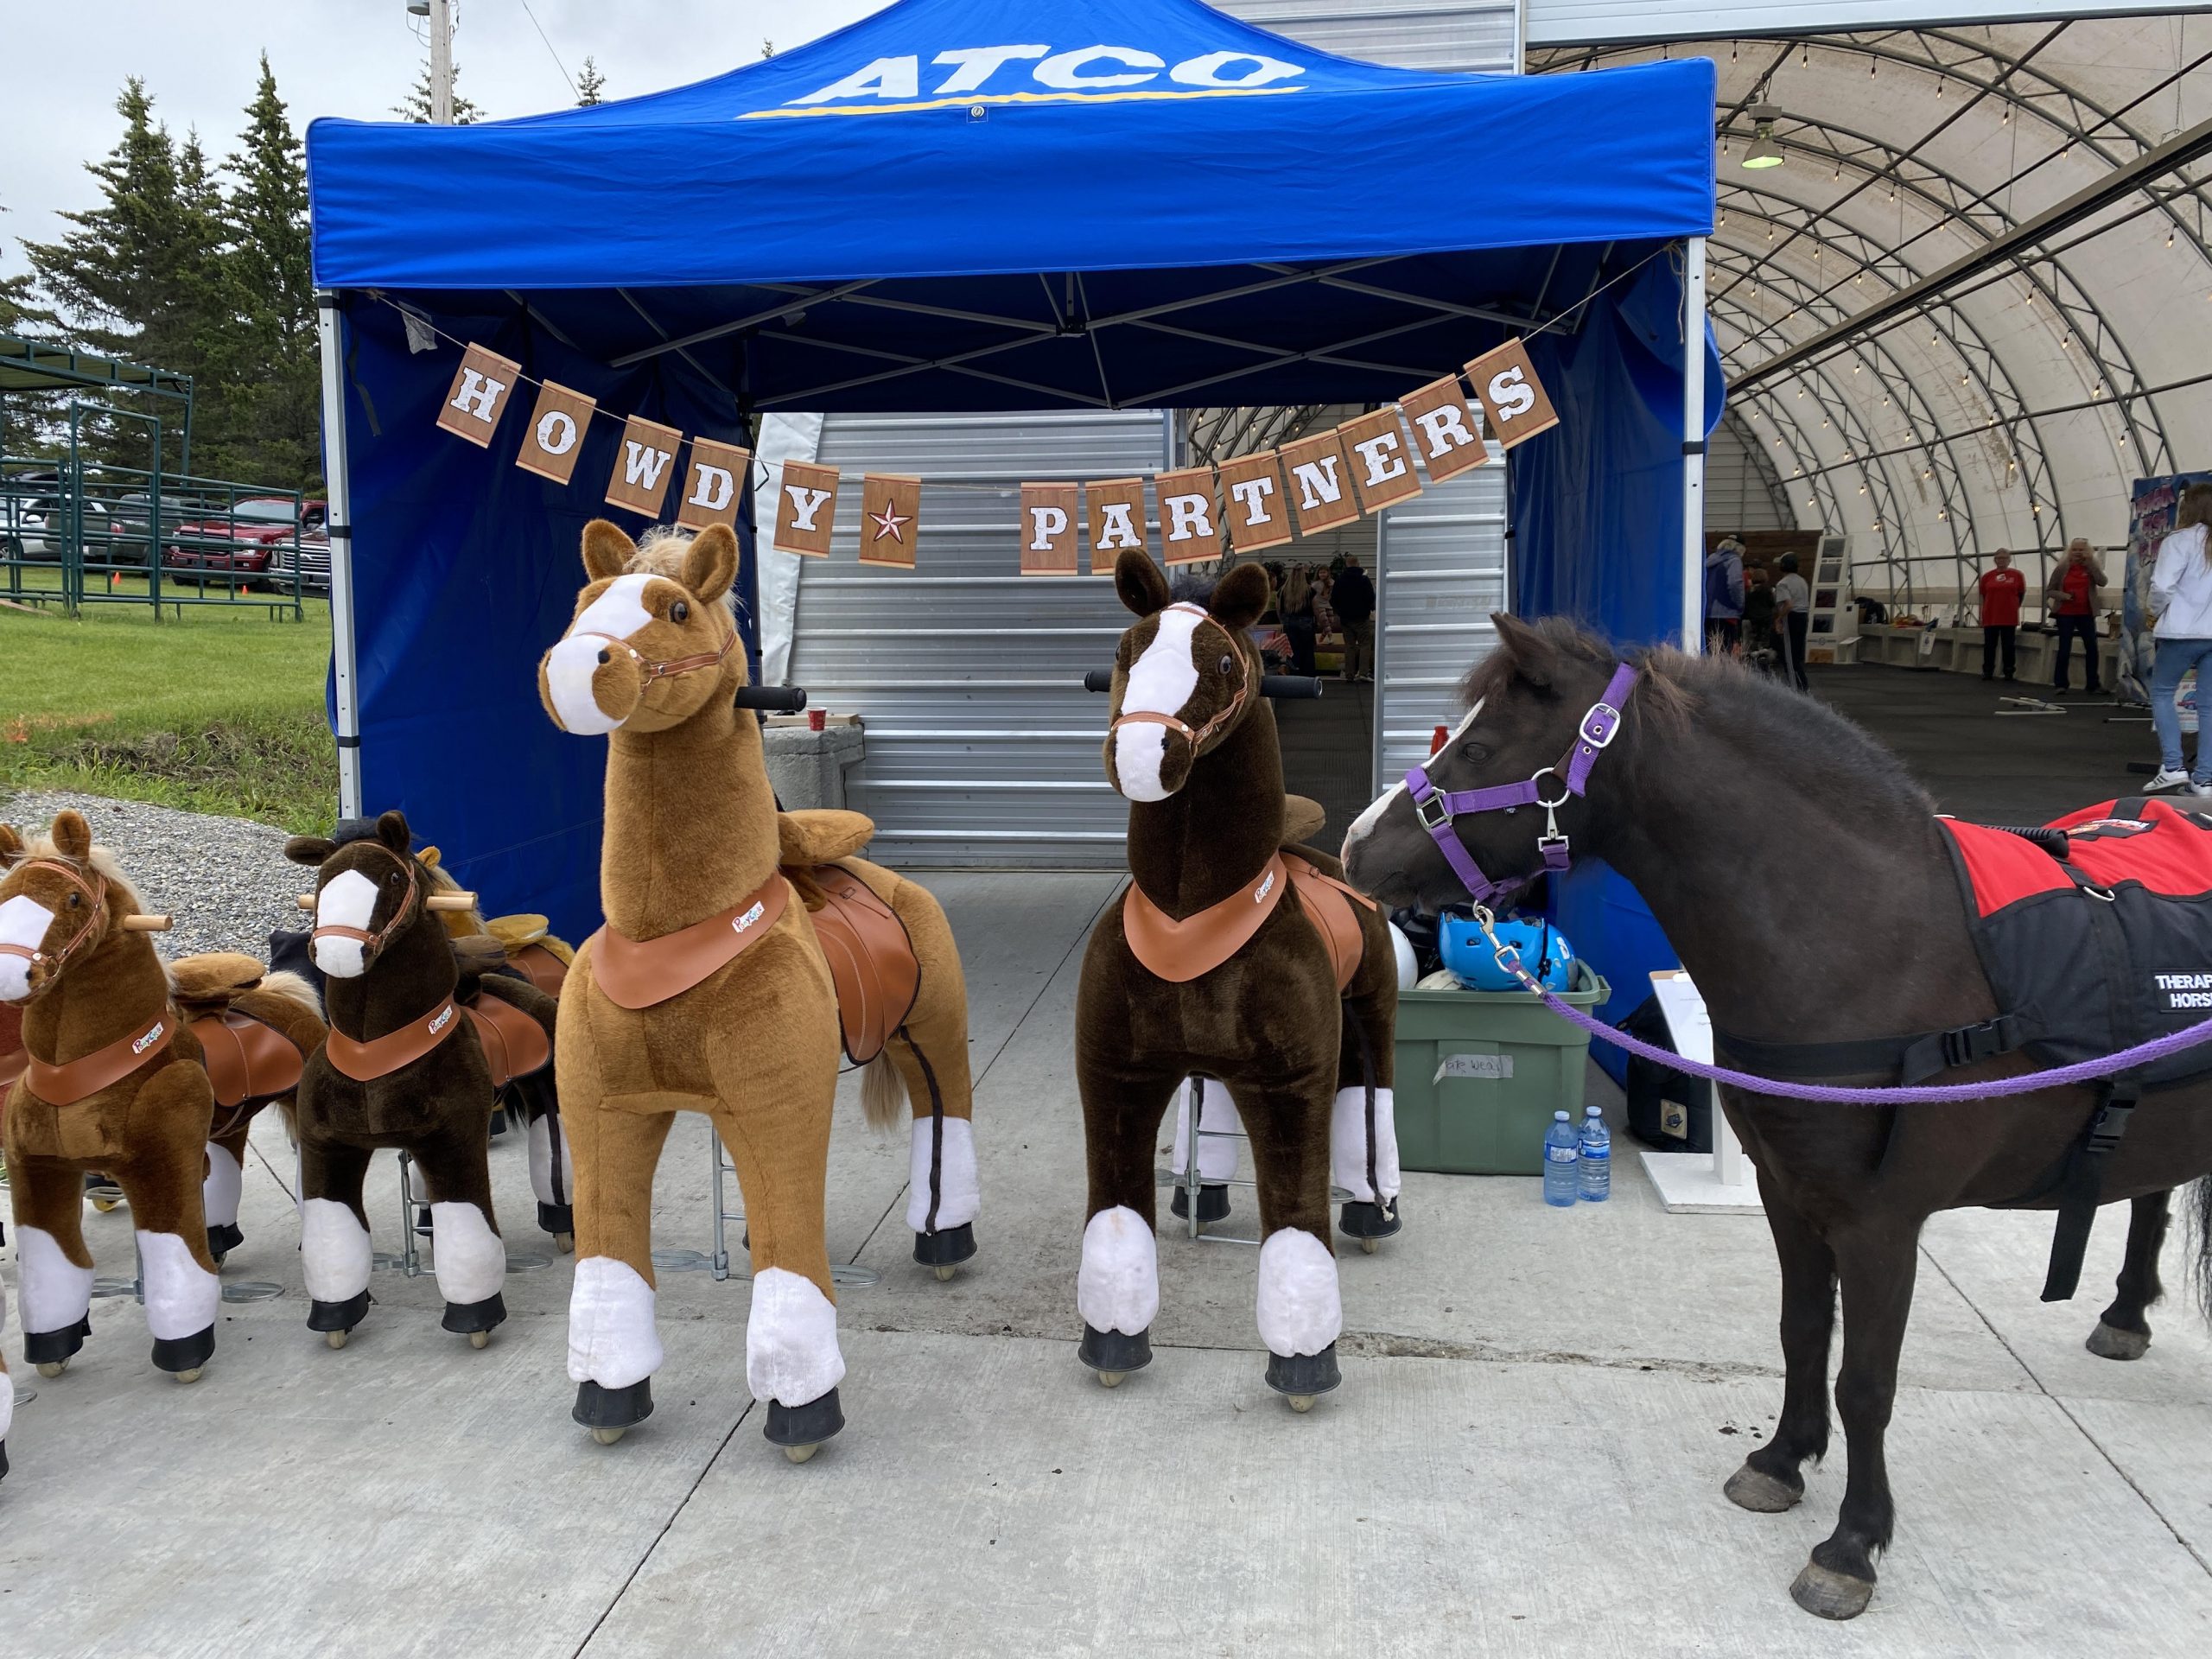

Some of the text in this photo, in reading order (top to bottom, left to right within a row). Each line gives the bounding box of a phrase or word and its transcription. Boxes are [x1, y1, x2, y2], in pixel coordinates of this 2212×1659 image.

[780, 44, 1306, 105] ATCO
[448, 364, 1536, 551] HOWDY PARTNERS
[2170, 992, 2212, 1007] HORS
